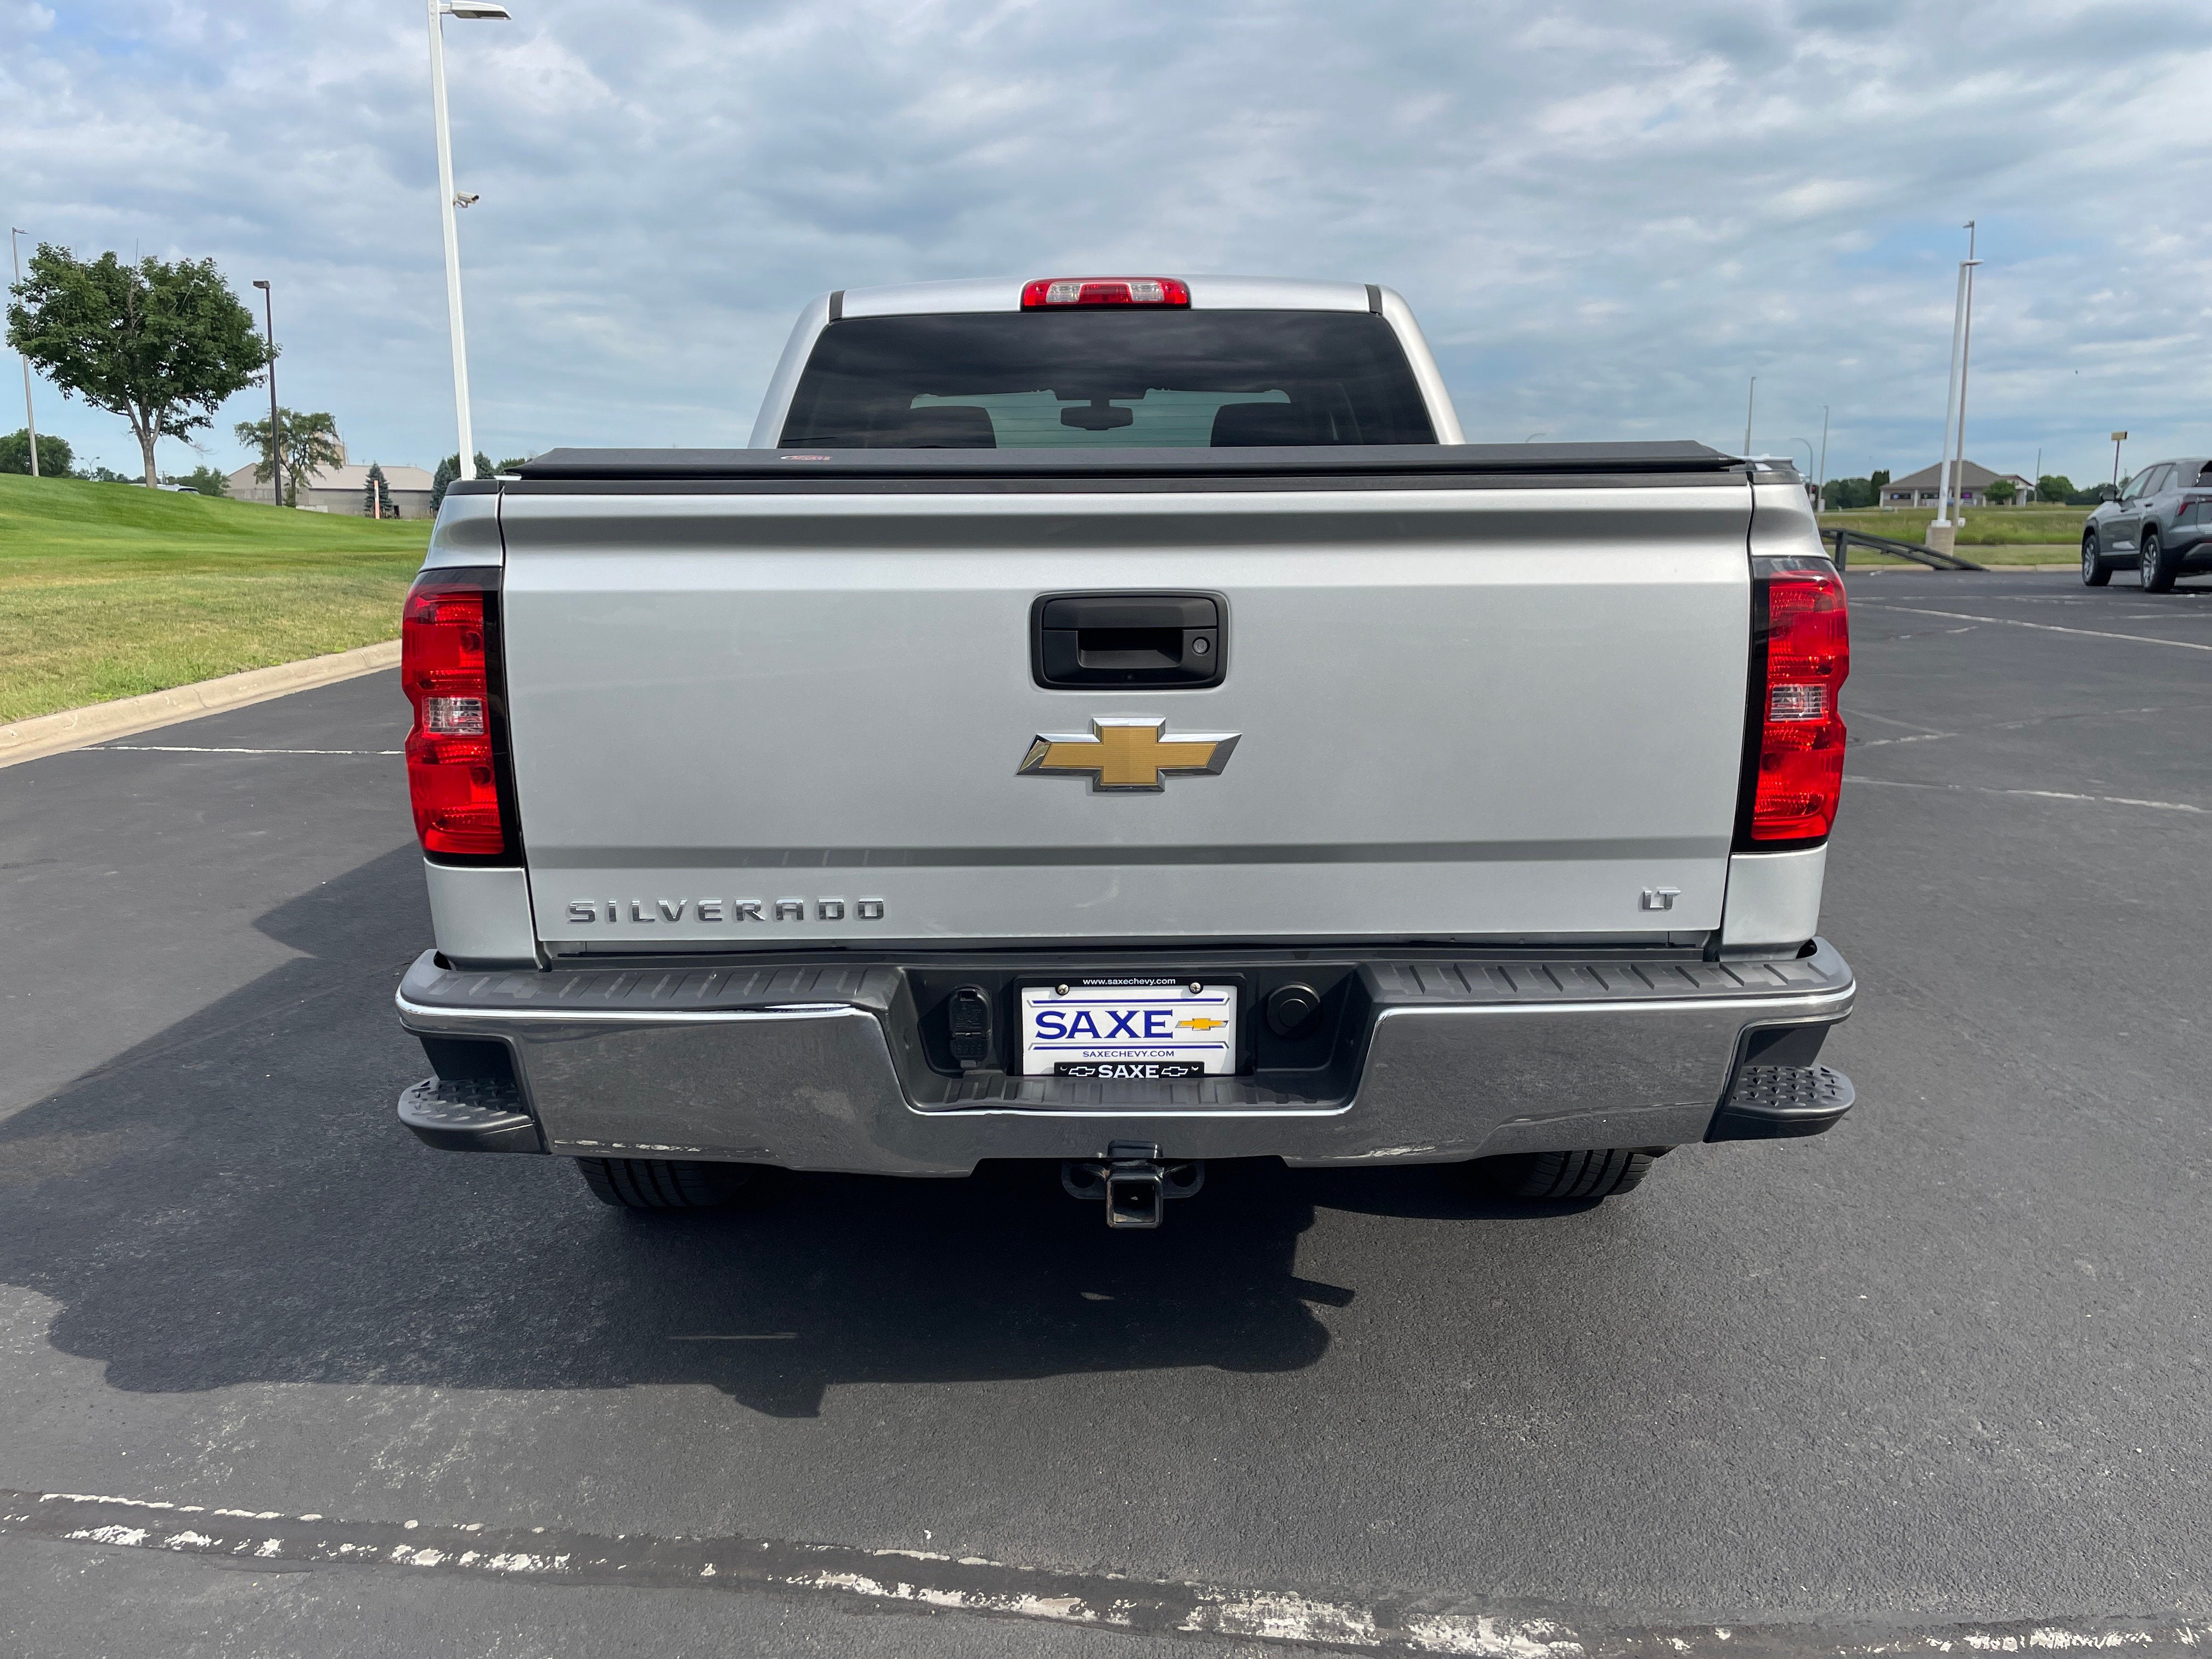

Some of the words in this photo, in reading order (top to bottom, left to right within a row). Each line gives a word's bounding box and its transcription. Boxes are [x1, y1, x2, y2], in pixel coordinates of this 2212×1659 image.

[569, 899, 885, 922] SILVERADO
[1643, 890, 1681, 910] LT
[1035, 1009, 1173, 1039] SAXE
[1098, 1064, 1159, 1079] SAXE
